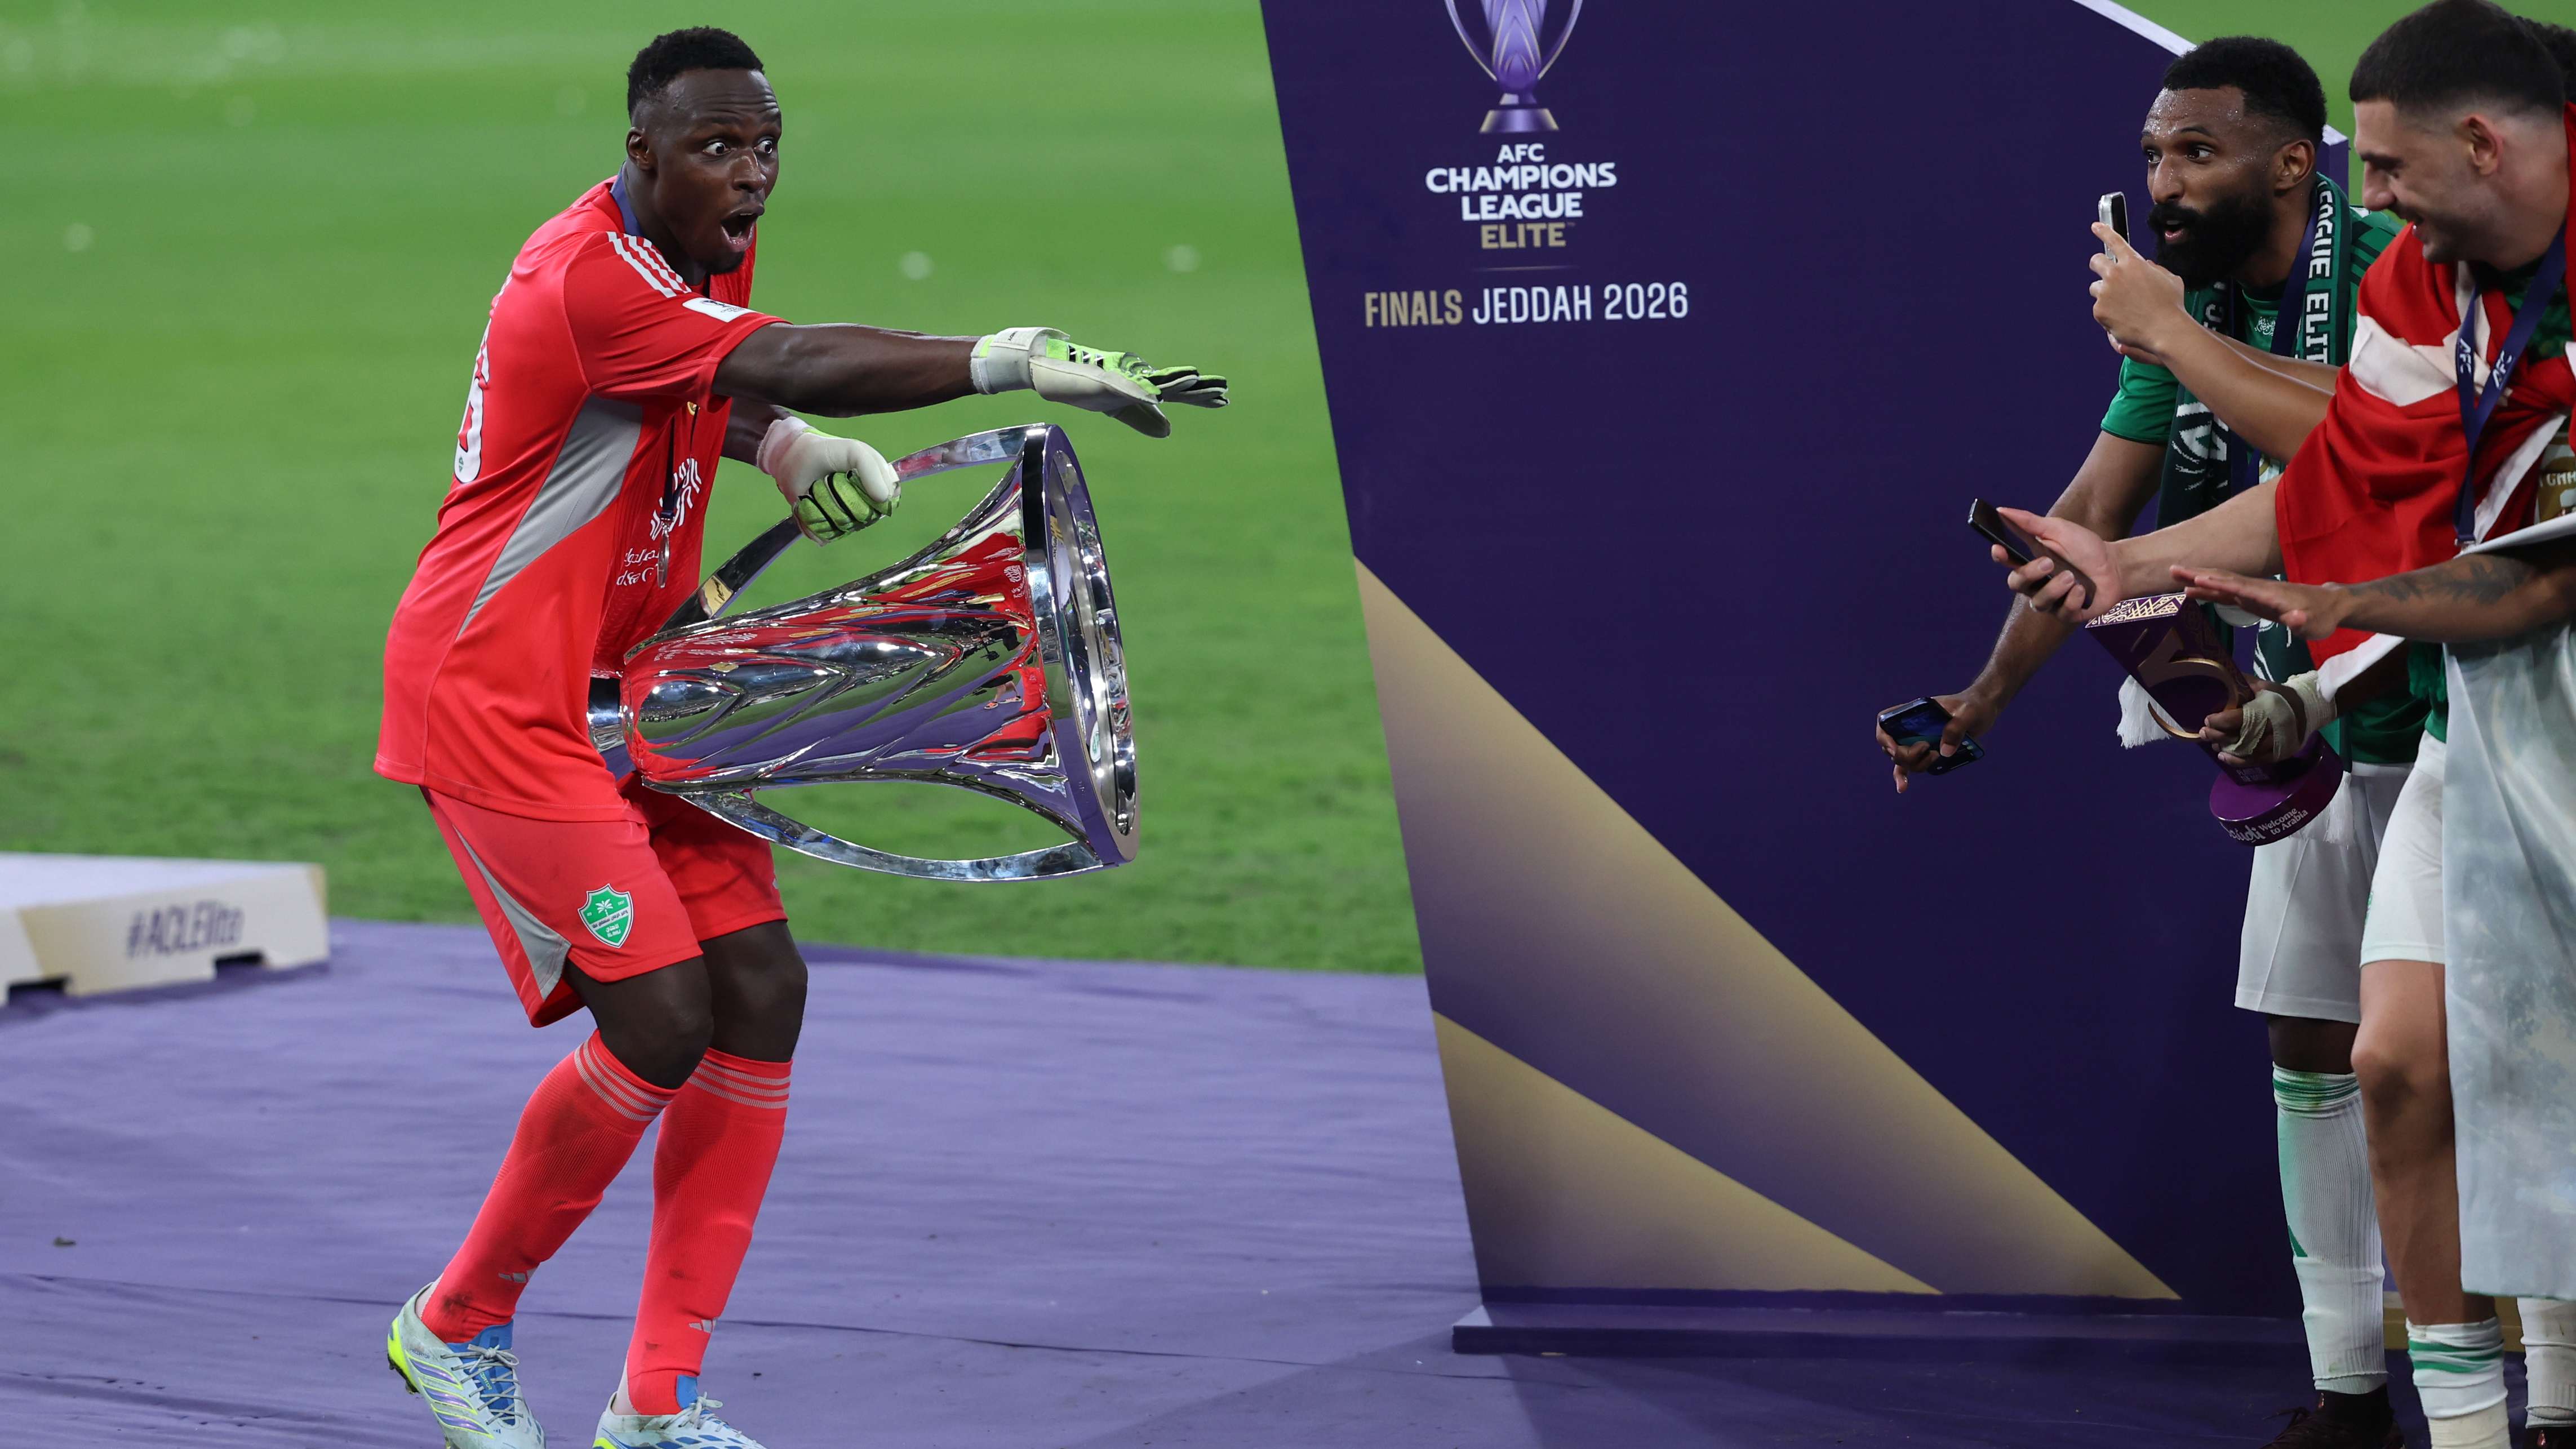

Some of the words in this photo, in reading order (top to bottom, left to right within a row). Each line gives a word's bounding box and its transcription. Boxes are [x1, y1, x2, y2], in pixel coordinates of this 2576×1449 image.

[1496, 143, 1545, 163] AFC
[1425, 162, 1617, 193] CHAMPIONS
[1461, 192, 1583, 221] LEAGUE
[1481, 222, 1566, 249] ELITE
[1365, 290, 1463, 327] FINALS
[1472, 285, 1592, 325] JEDDAH
[1604, 282, 1688, 320] 2026
[2306, 292, 2329, 364] ELIT
[2459, 337, 2472, 375] AFC
[2493, 350, 2512, 388] AFC
[2258, 808, 2298, 832] Welcome
[2270, 827, 2281, 835] to
[2281, 809, 2308, 831] Arabia
